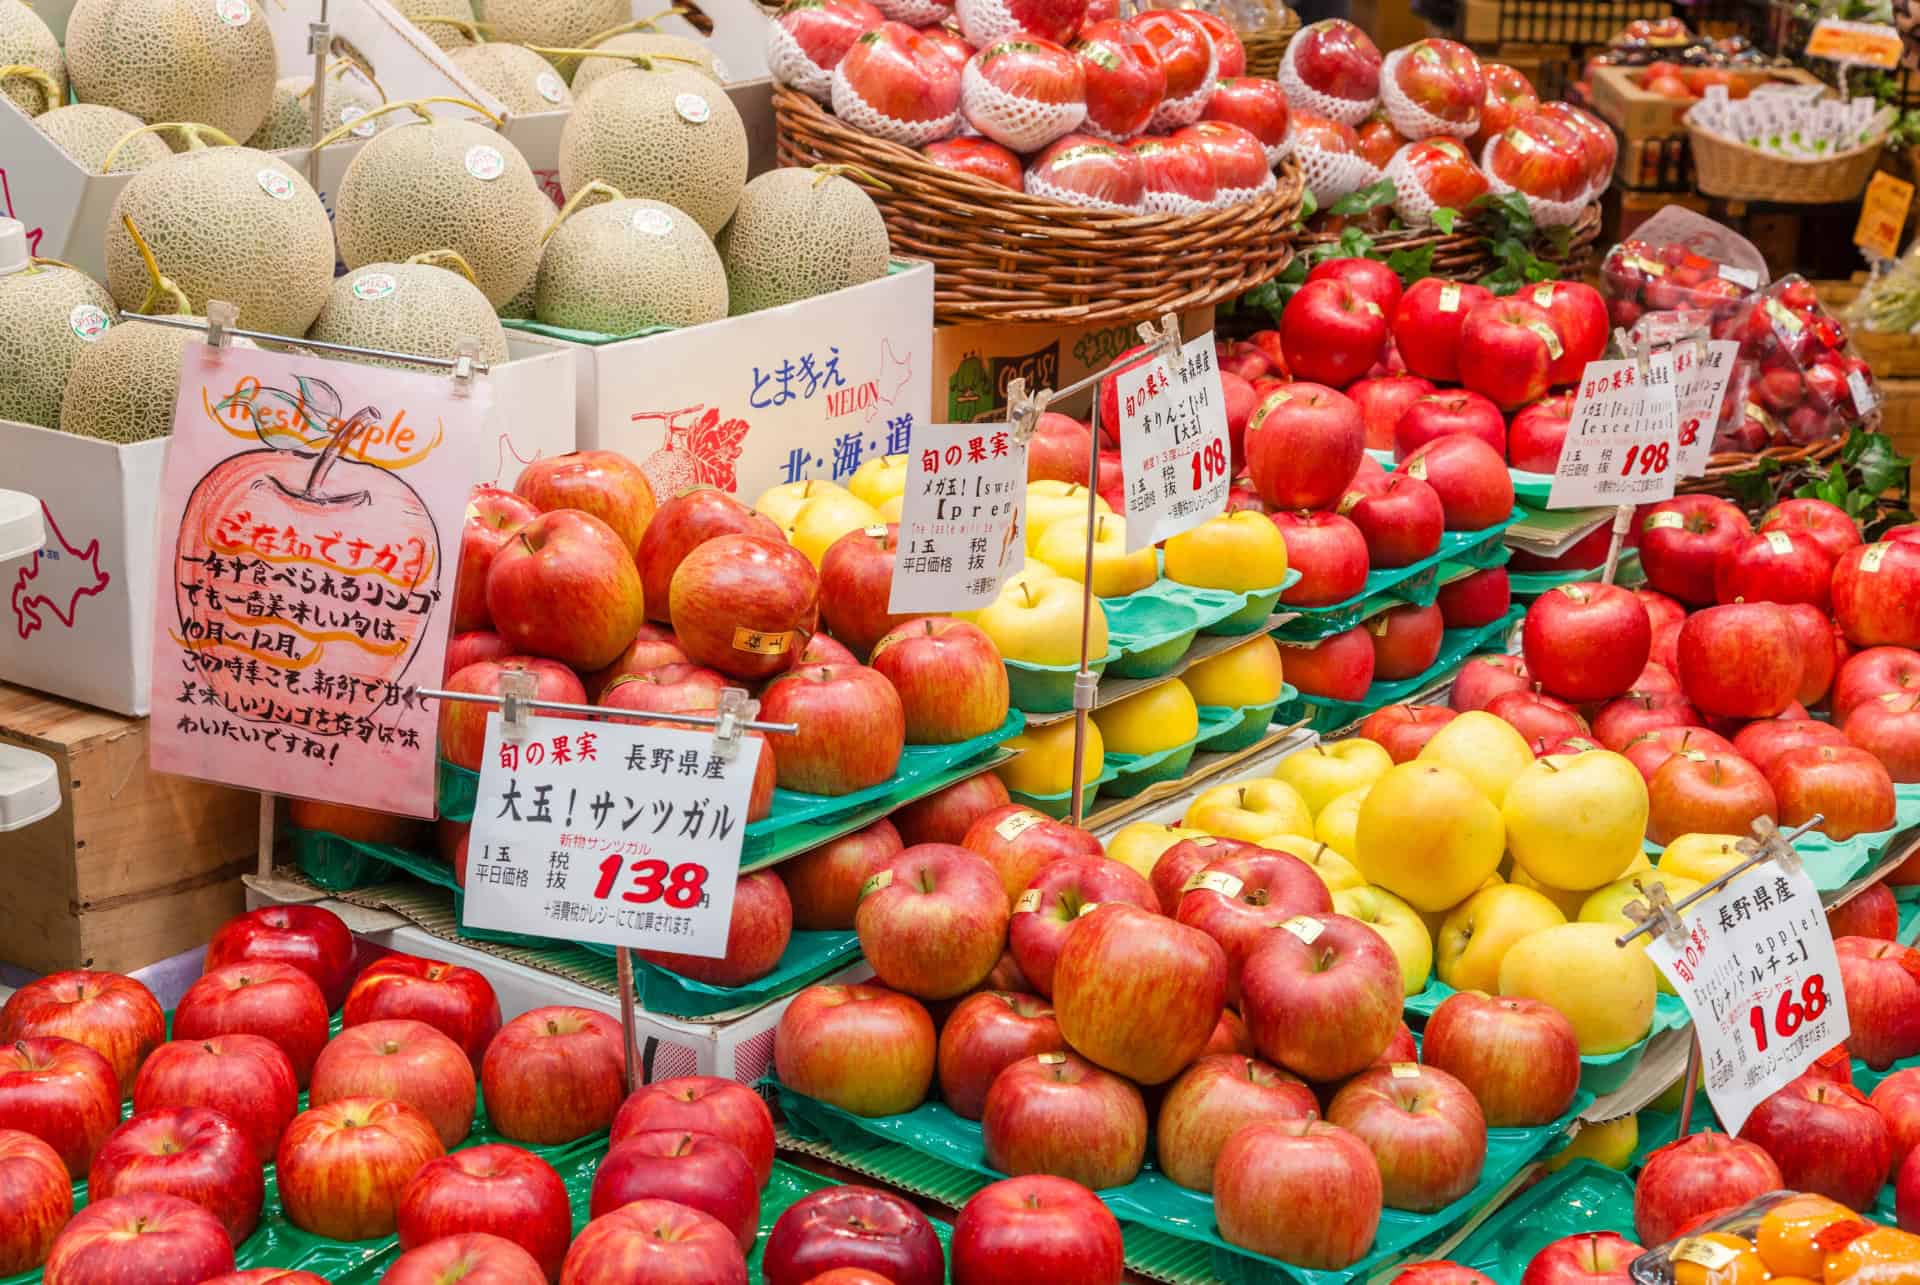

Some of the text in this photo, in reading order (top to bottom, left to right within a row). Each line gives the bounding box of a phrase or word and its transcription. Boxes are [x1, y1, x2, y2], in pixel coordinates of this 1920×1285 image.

[826, 379, 880, 419] MELON
[1126, 366, 1168, 417] 旬の果実
[224, 376, 416, 459] fresh apple
[922, 432, 1008, 474] 旬の果実
[1621, 441, 1670, 476] 198
[181, 551, 441, 614] 一年中食べられるリンゴ
[904, 556, 952, 573] 平日価格
[499, 732, 599, 772] 旬の果実
[624, 744, 726, 780] 長野県産
[497, 779, 735, 841] 大玉！サンツガル
[560, 833, 652, 856] 新物サンツガル
[475, 864, 529, 888] 平日価格
[1718, 877, 1796, 934] 長野県産
[1672, 917, 1709, 984] 旬の果実
[1755, 908, 1819, 955] apple!
